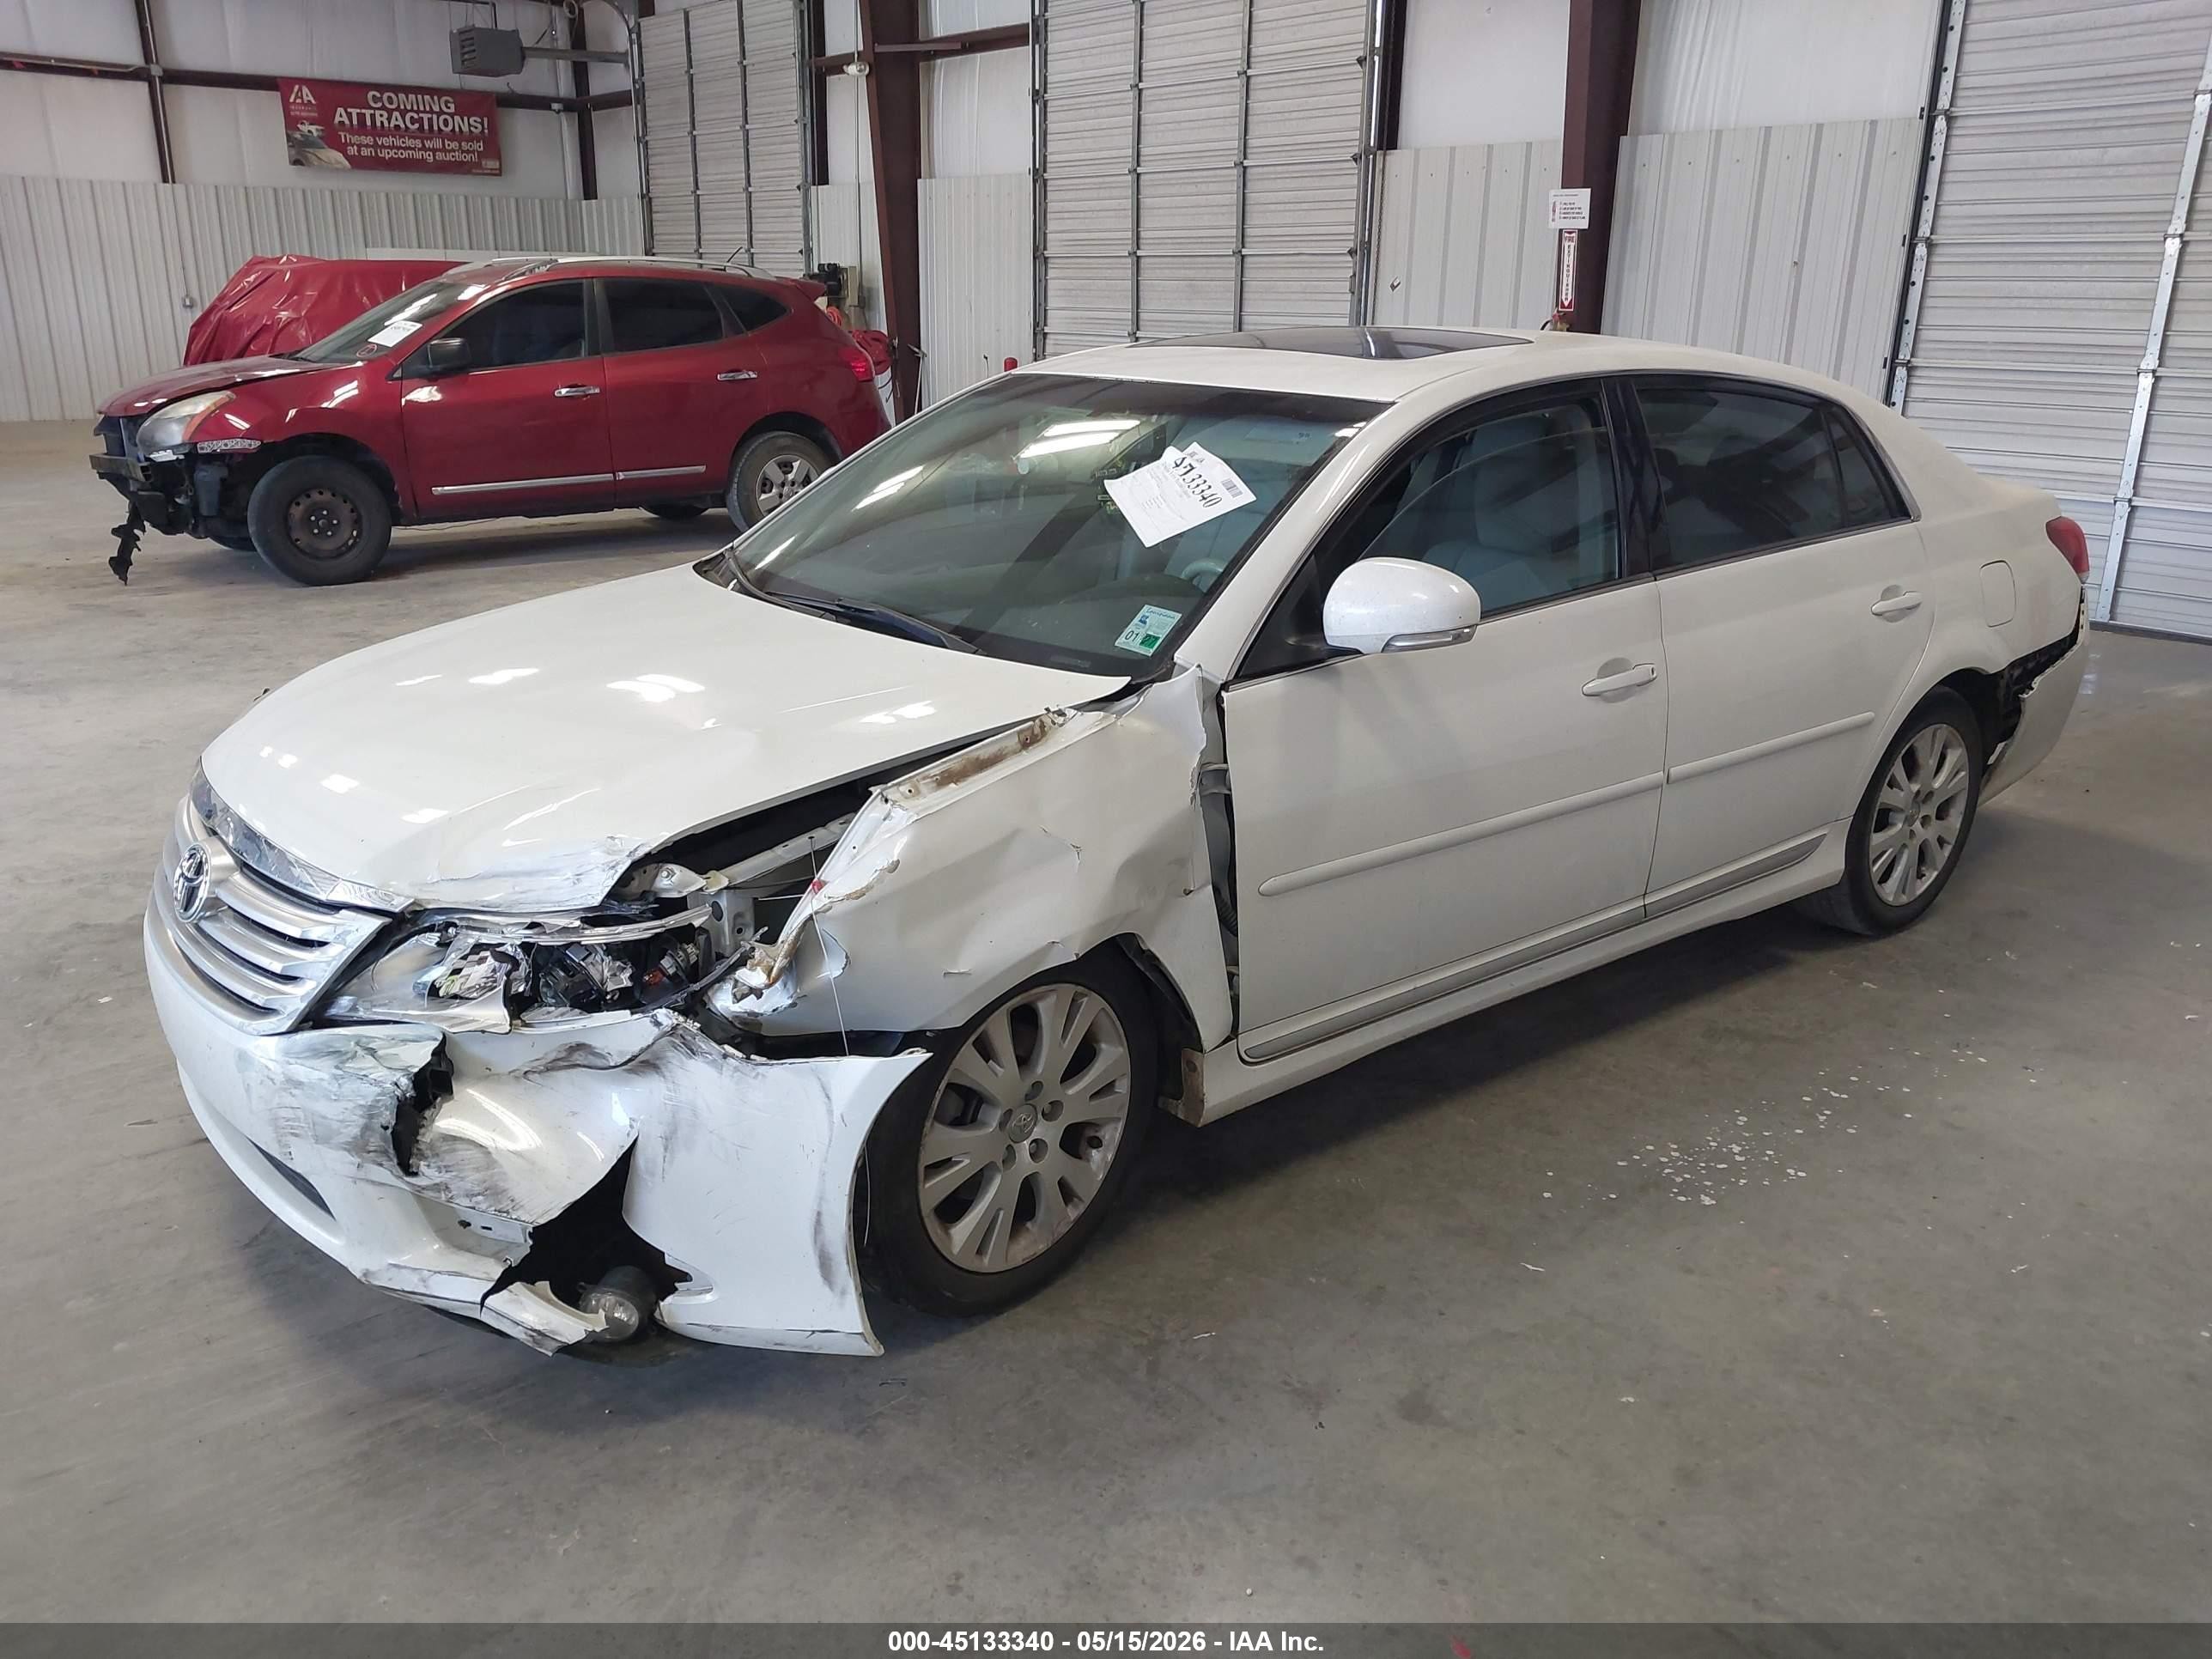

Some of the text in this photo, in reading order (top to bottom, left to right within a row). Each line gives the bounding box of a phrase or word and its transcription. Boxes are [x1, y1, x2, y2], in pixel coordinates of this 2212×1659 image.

[367, 91, 455, 112] COMING
[333, 107, 489, 133] ATTRACTIONS!
[340, 132, 483, 152] These vehicles will be sold
[347, 145, 478, 162] at an upcoming auction!
[1125, 630, 1139, 642] 01
